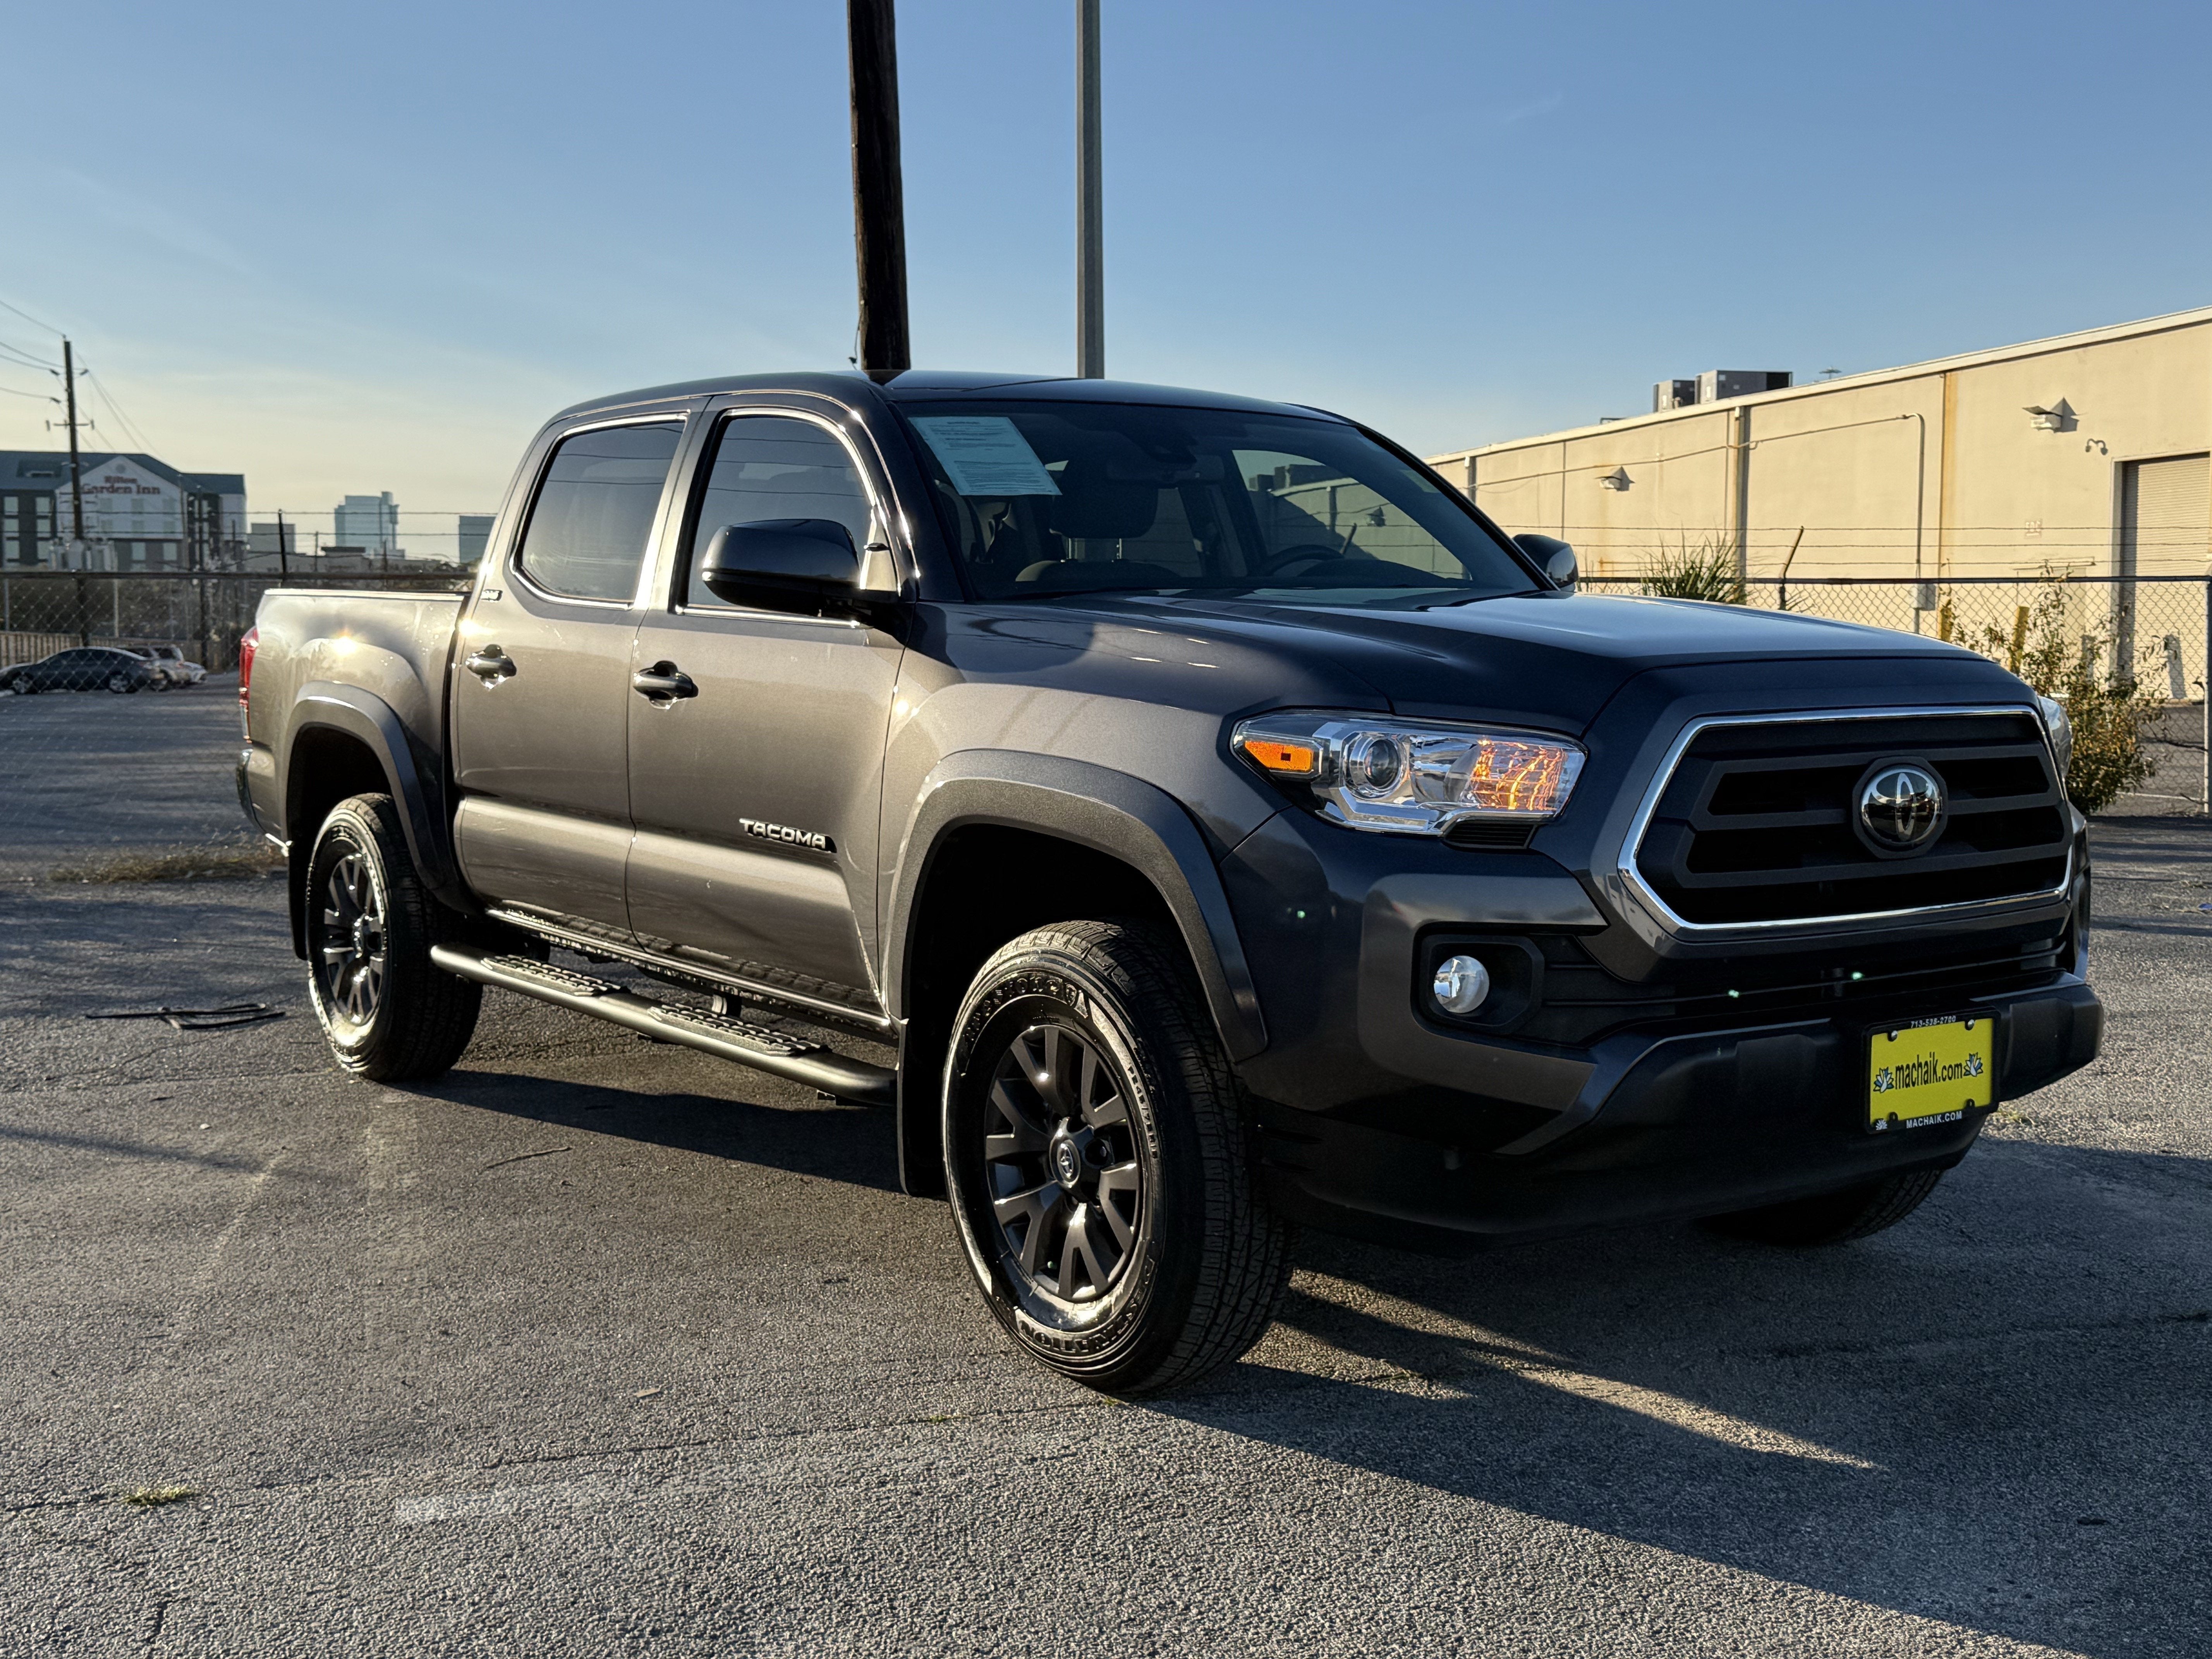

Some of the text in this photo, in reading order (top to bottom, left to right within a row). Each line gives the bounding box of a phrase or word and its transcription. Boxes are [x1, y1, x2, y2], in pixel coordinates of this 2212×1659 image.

[81, 483, 161, 495] Garden Inn
[739, 818, 826, 850] TACOMA
[1895, 1051, 1963, 1090] machaik.com
[1906, 1110, 1962, 1128] MACHAIK.COM
